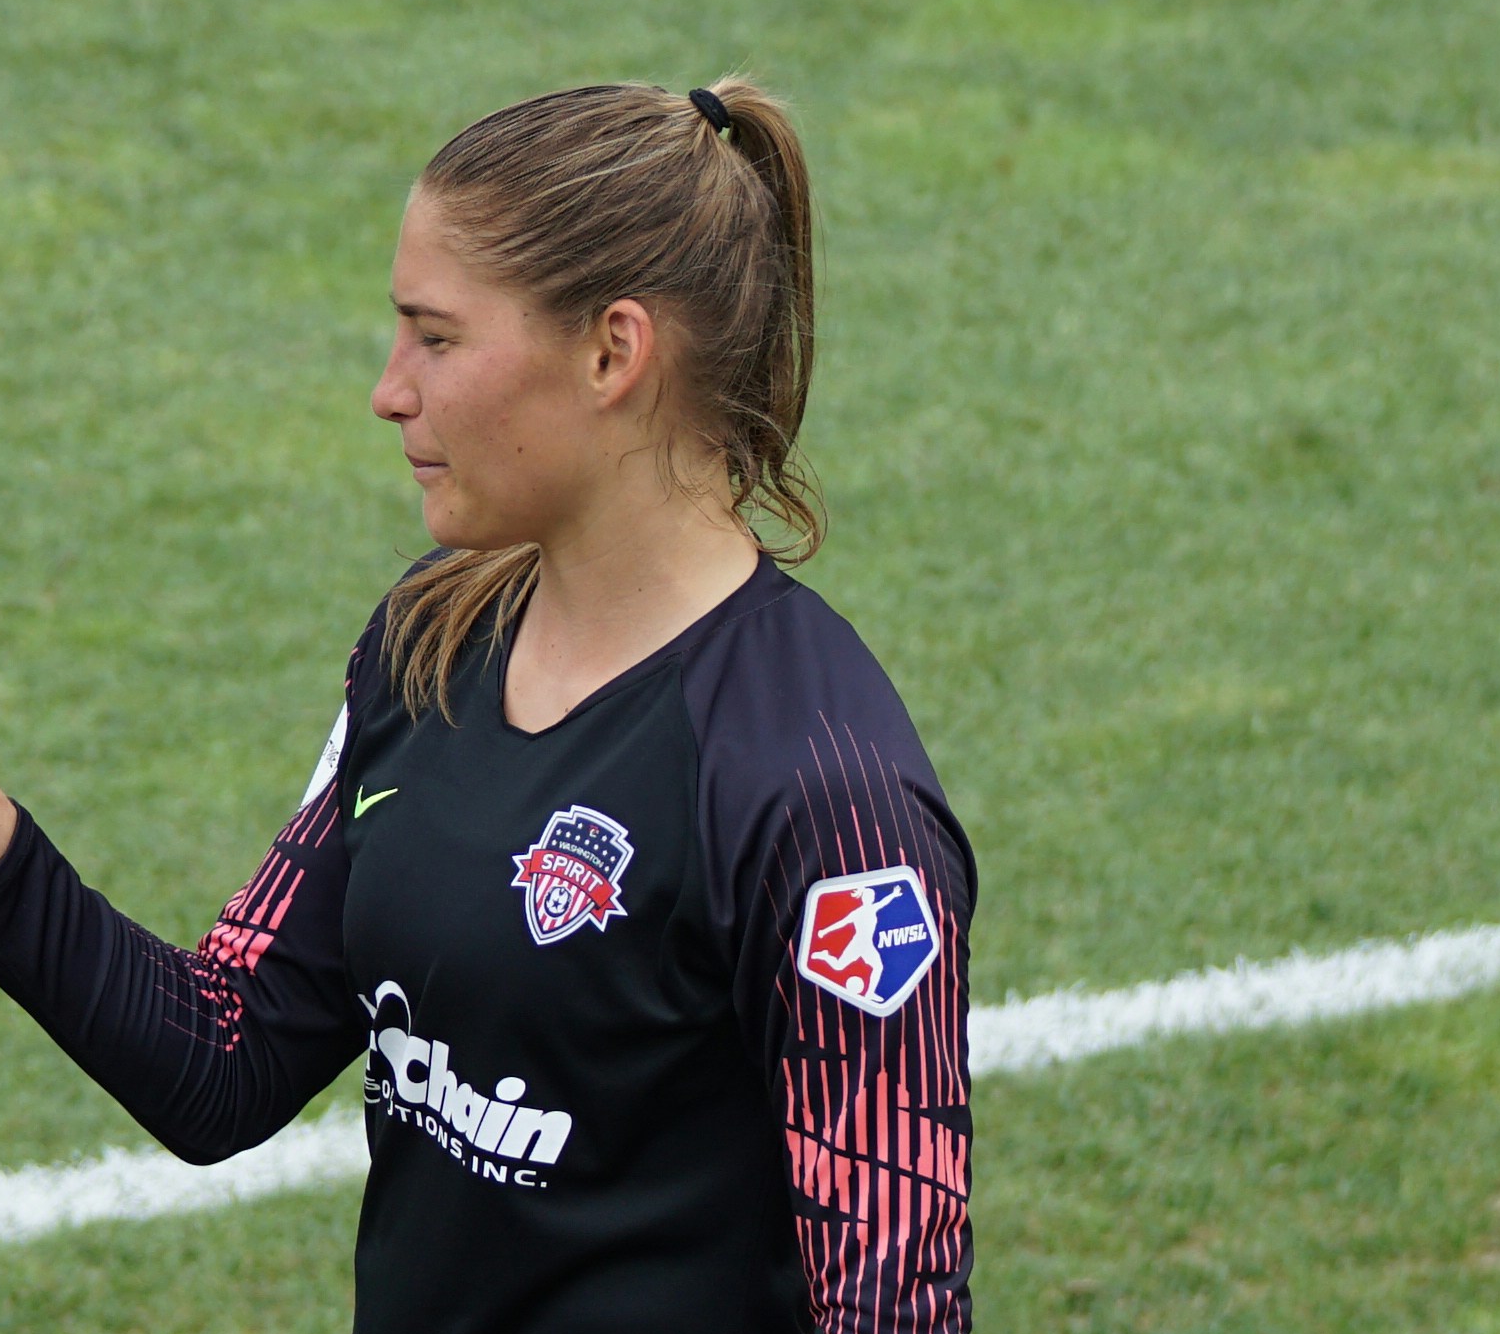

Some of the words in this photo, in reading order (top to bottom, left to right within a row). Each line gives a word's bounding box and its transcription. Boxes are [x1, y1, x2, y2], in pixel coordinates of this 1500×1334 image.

[559, 840, 605, 869] WASHINGTON
[541, 853, 604, 892] SPIRIT
[877, 922, 928, 949] NWSL
[471, 1155, 548, 1189] INC.
